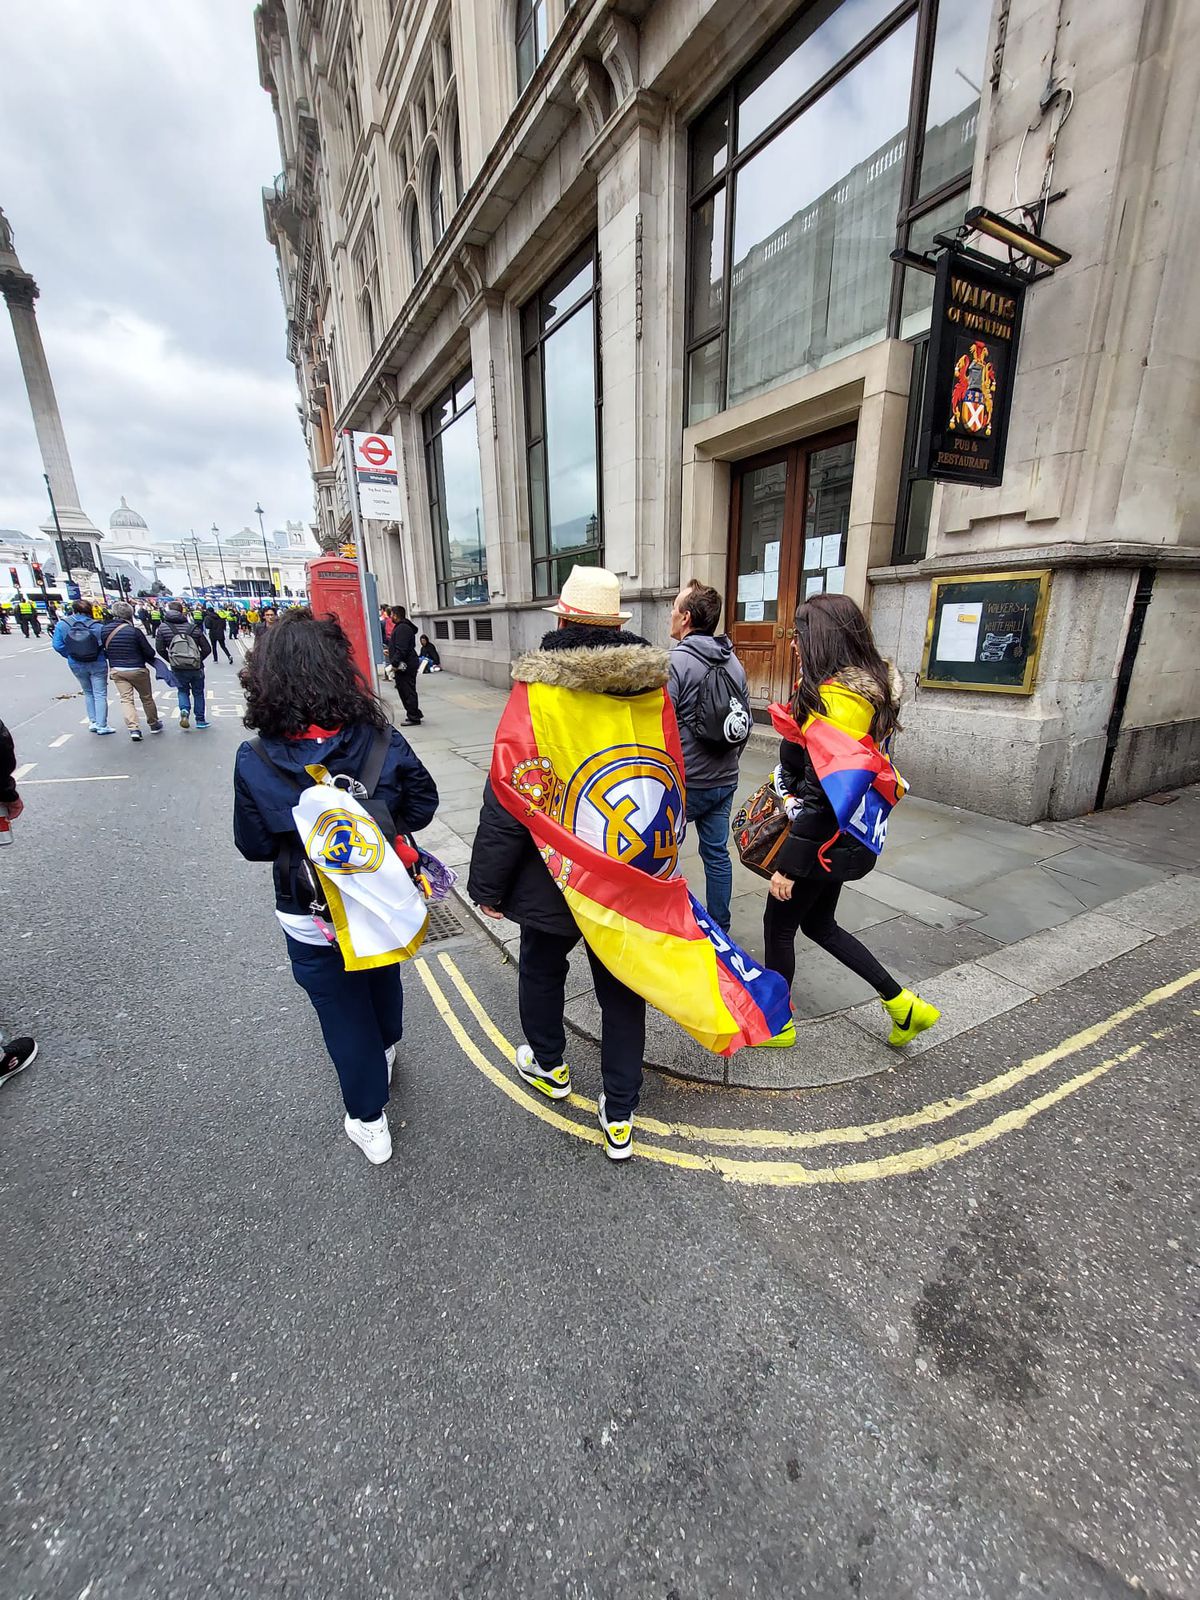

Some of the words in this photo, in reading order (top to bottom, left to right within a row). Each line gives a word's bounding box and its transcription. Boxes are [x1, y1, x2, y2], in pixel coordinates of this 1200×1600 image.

[951, 276, 1016, 319] WALKERS
[954, 438, 970, 451] PUB
[971, 441, 978, 452] &
[937, 451, 990, 470] RESTAURANT
